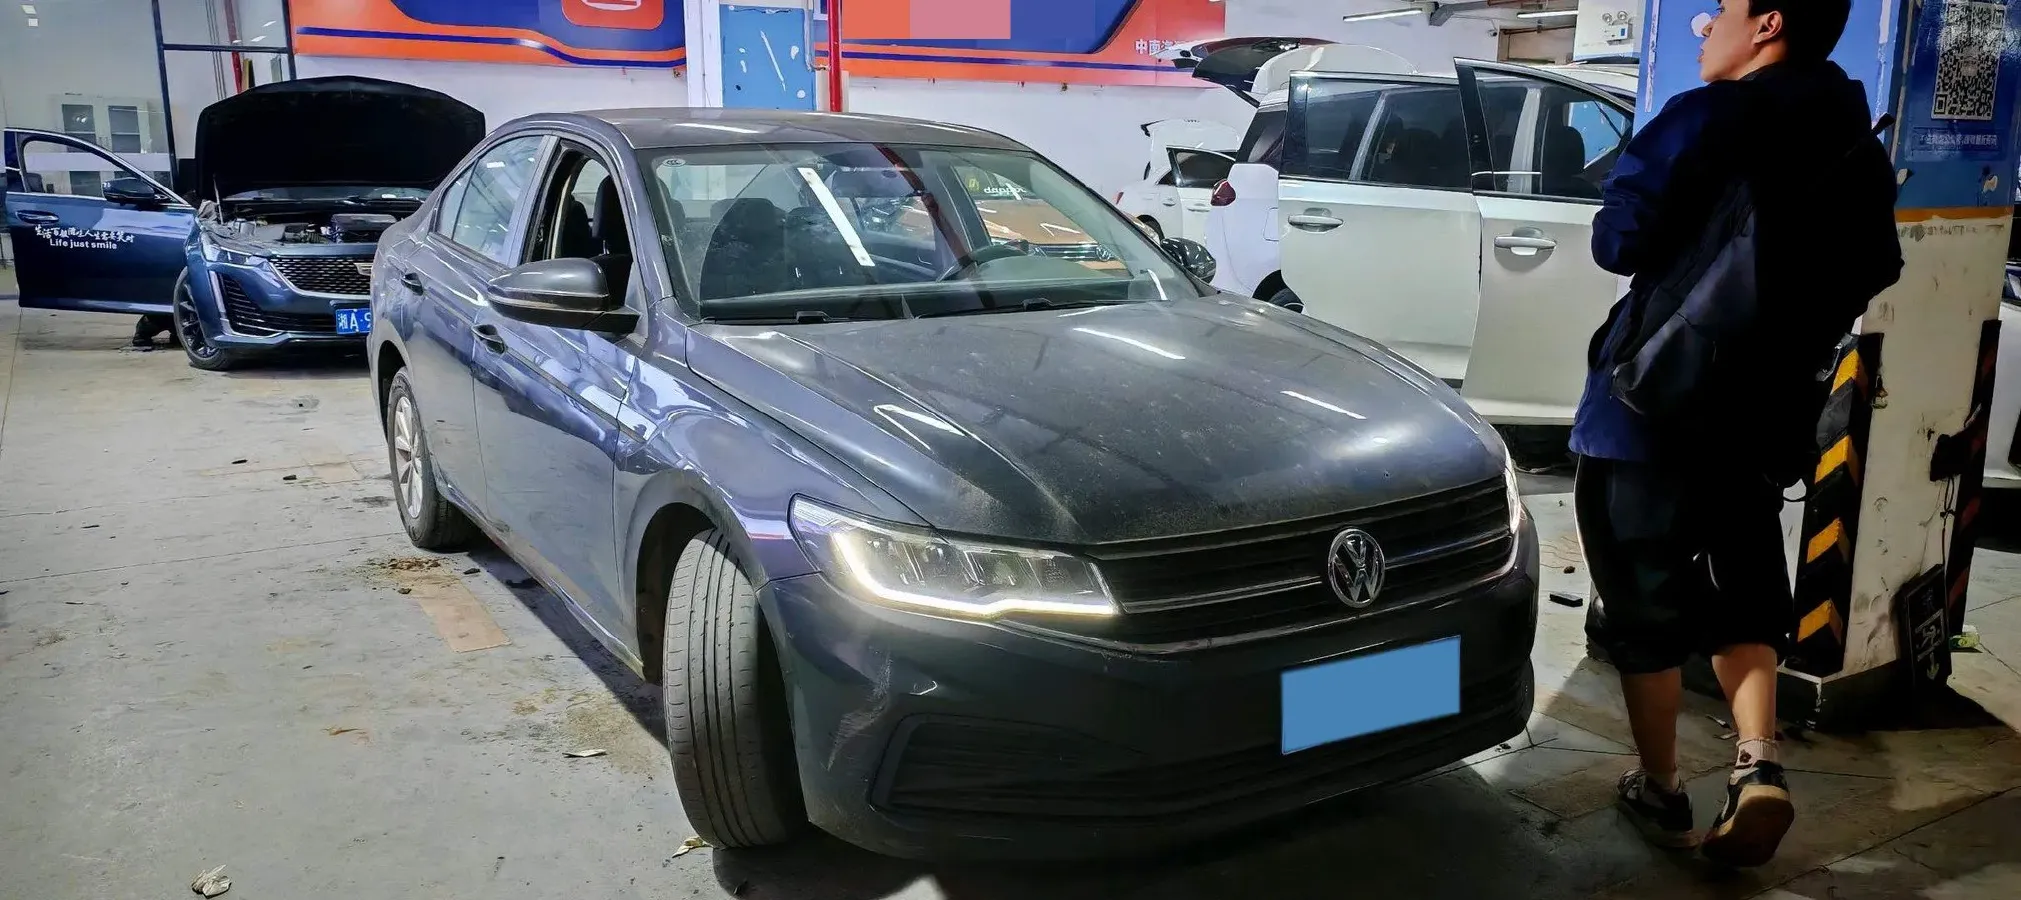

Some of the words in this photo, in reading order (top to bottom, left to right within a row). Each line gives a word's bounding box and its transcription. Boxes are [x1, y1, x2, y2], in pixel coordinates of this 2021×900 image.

[50, 239, 68, 247] Life
[70, 239, 89, 249] just
[91, 240, 117, 250] smile
